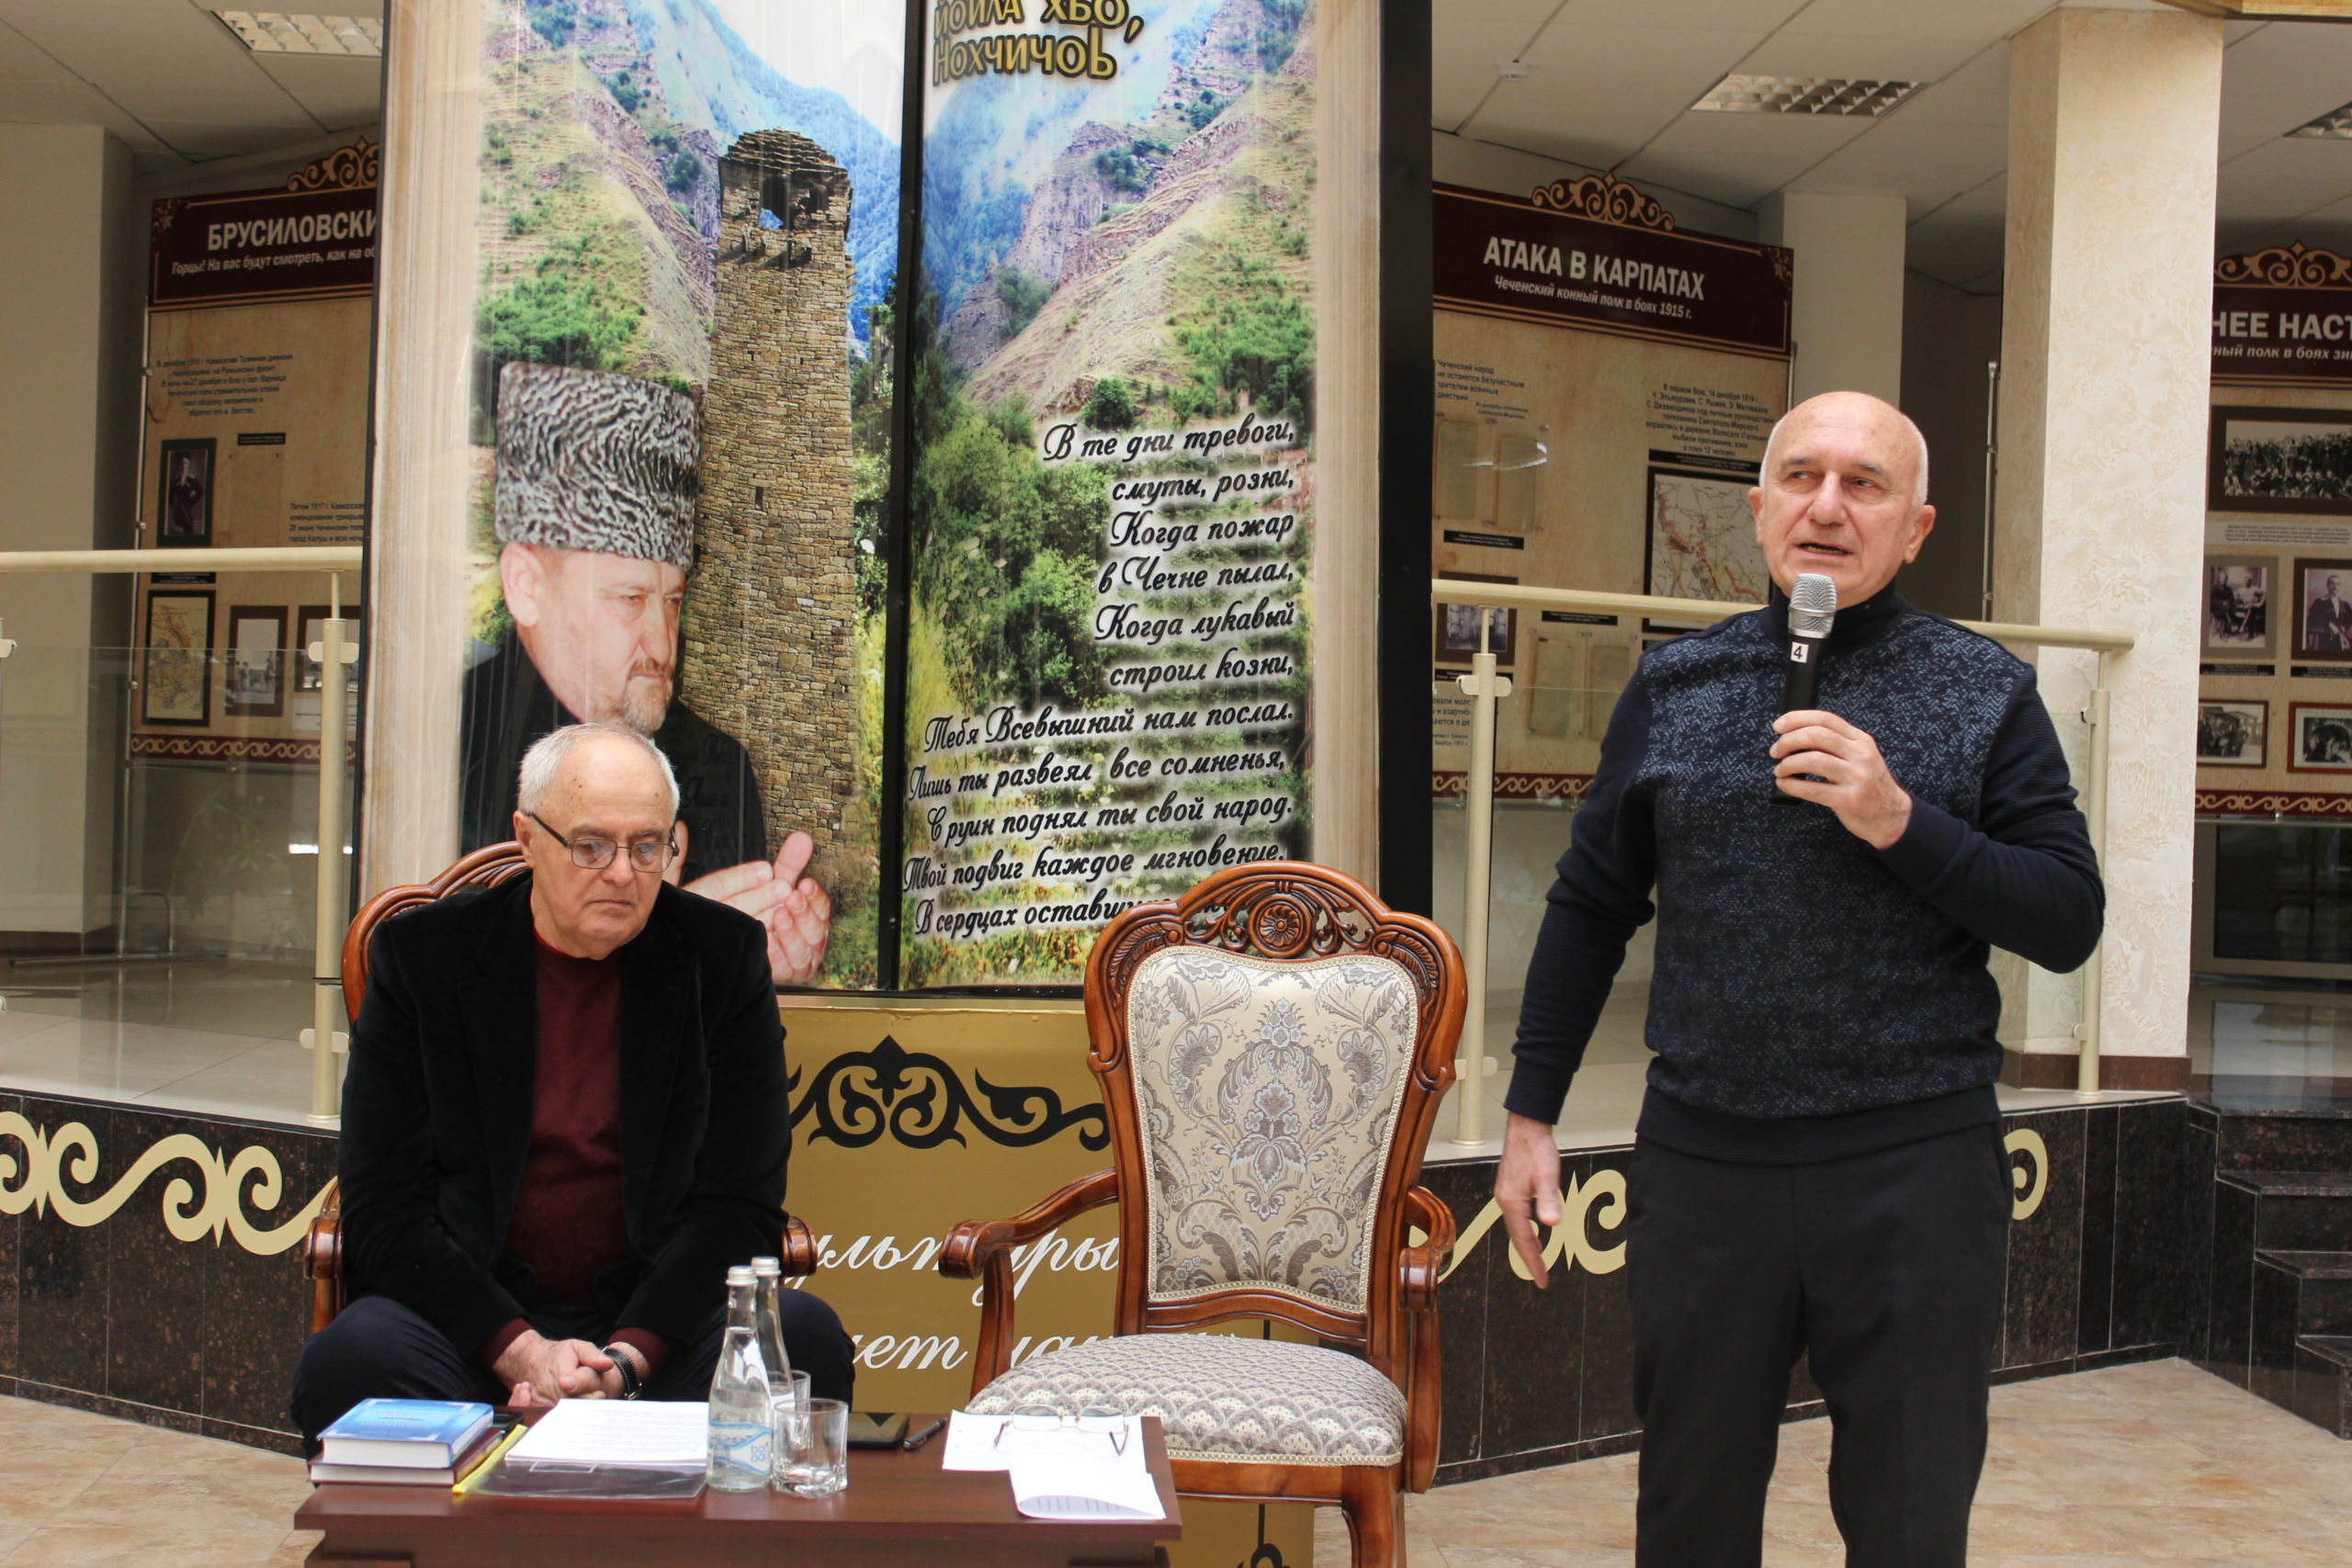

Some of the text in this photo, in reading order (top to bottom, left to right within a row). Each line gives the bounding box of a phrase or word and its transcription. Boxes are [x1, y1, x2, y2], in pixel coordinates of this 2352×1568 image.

[208, 258, 220, 271] На
[222, 259, 242, 270] вас
[243, 254, 271, 271] будут
[1483, 236, 1704, 301] АТАКА В КАРПАТАХ
[1494, 275, 1692, 320] Чеченский конный полк в боях 1915 г.
[2212, 344, 2243, 357] ный
[2247, 346, 2280, 358] полк
[2283, 347, 2292, 358] в
[2296, 344, 2329, 359] боях
[1044, 412, 1294, 463] В те дни тревоги,
[1113, 467, 1294, 506] смуты, розни,
[1111, 511, 1294, 551] Когда пожар
[1098, 556, 1294, 594] в Чечне пылал,
[1095, 596, 1294, 645] Когда лукавый
[1110, 648, 1294, 694] строил козни,
[1793, 646, 1803, 660] 4
[924, 703, 1293, 752] Тебя Всевышний нам послал.
[909, 746, 1284, 801] Лишь ты развеял все сомненья,
[926, 791, 1293, 848] С руин поднял ты свой народ.
[902, 856, 947, 893] Твой
[952, 849, 1023, 891] подвиг
[1032, 845, 1135, 883] каждое
[915, 898, 935, 935] В
[935, 908, 1017, 939] сердцах
